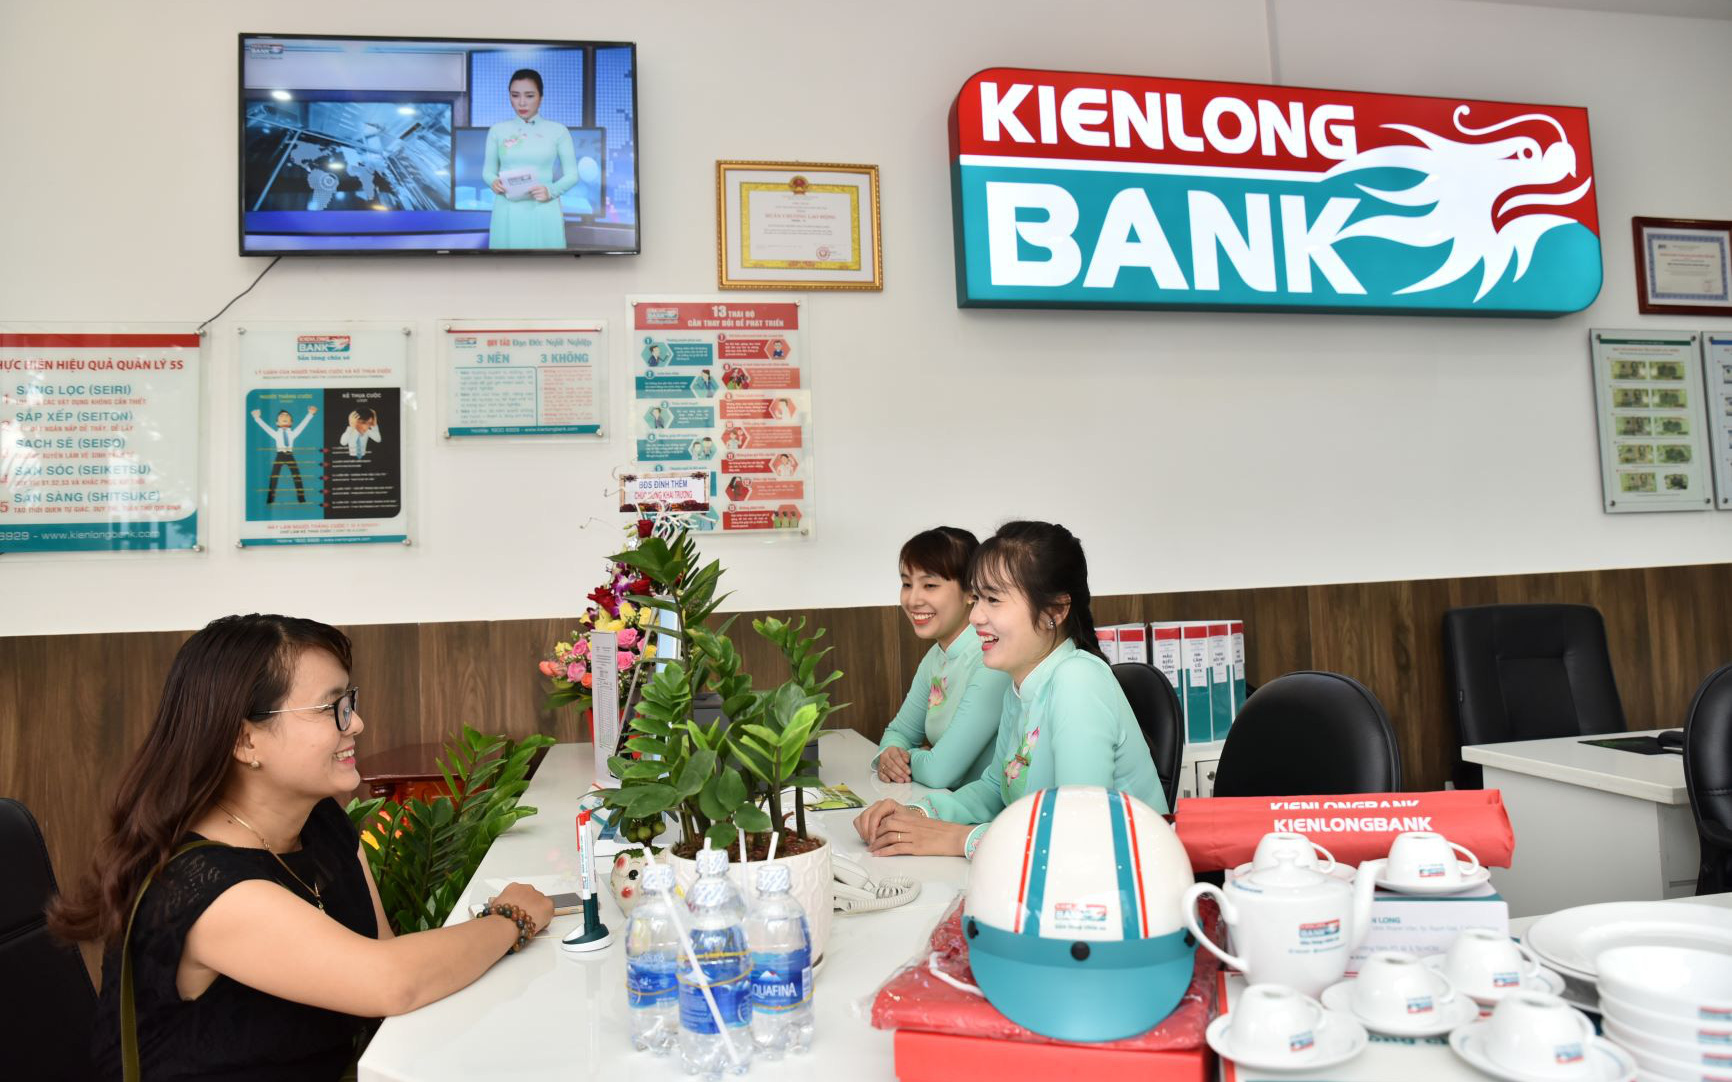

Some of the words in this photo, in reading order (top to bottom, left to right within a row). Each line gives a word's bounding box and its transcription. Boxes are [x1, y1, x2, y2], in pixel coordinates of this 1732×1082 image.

[979, 80, 1358, 160] KIENLONG
[985, 181, 1368, 295] BANK
[712, 305, 727, 318] 13
[299, 343, 329, 352] BANK
[476, 354, 483, 363] 3
[487, 351, 510, 363] NÊN
[540, 354, 548, 363] 3
[551, 351, 589, 363] KHÔNG
[56, 359, 85, 373] HIỆU
[88, 357, 114, 371] QUẢ
[116, 357, 151, 371] QUẢN
[154, 357, 166, 370] LÝ
[170, 359, 184, 370] 5S
[58, 384, 85, 397] LỌC
[89, 384, 132, 396] (SEIRI)
[16, 407, 42, 422] SẮP
[47, 408, 73, 422] XẾP
[77, 411, 134, 423] (SEITON)
[78, 438, 125, 449] (SEISO)
[46, 464, 74, 475] SÓC
[78, 464, 151, 476] (SEIKETSU)
[46, 490, 83, 503] SÀNG
[87, 490, 161, 503] (SHITSUKE)
[42, 530, 161, 541] www.kienlongbank.com
[1273, 816, 1433, 833] KIENLONGBANK
[751, 982, 798, 999] QUAFINA
